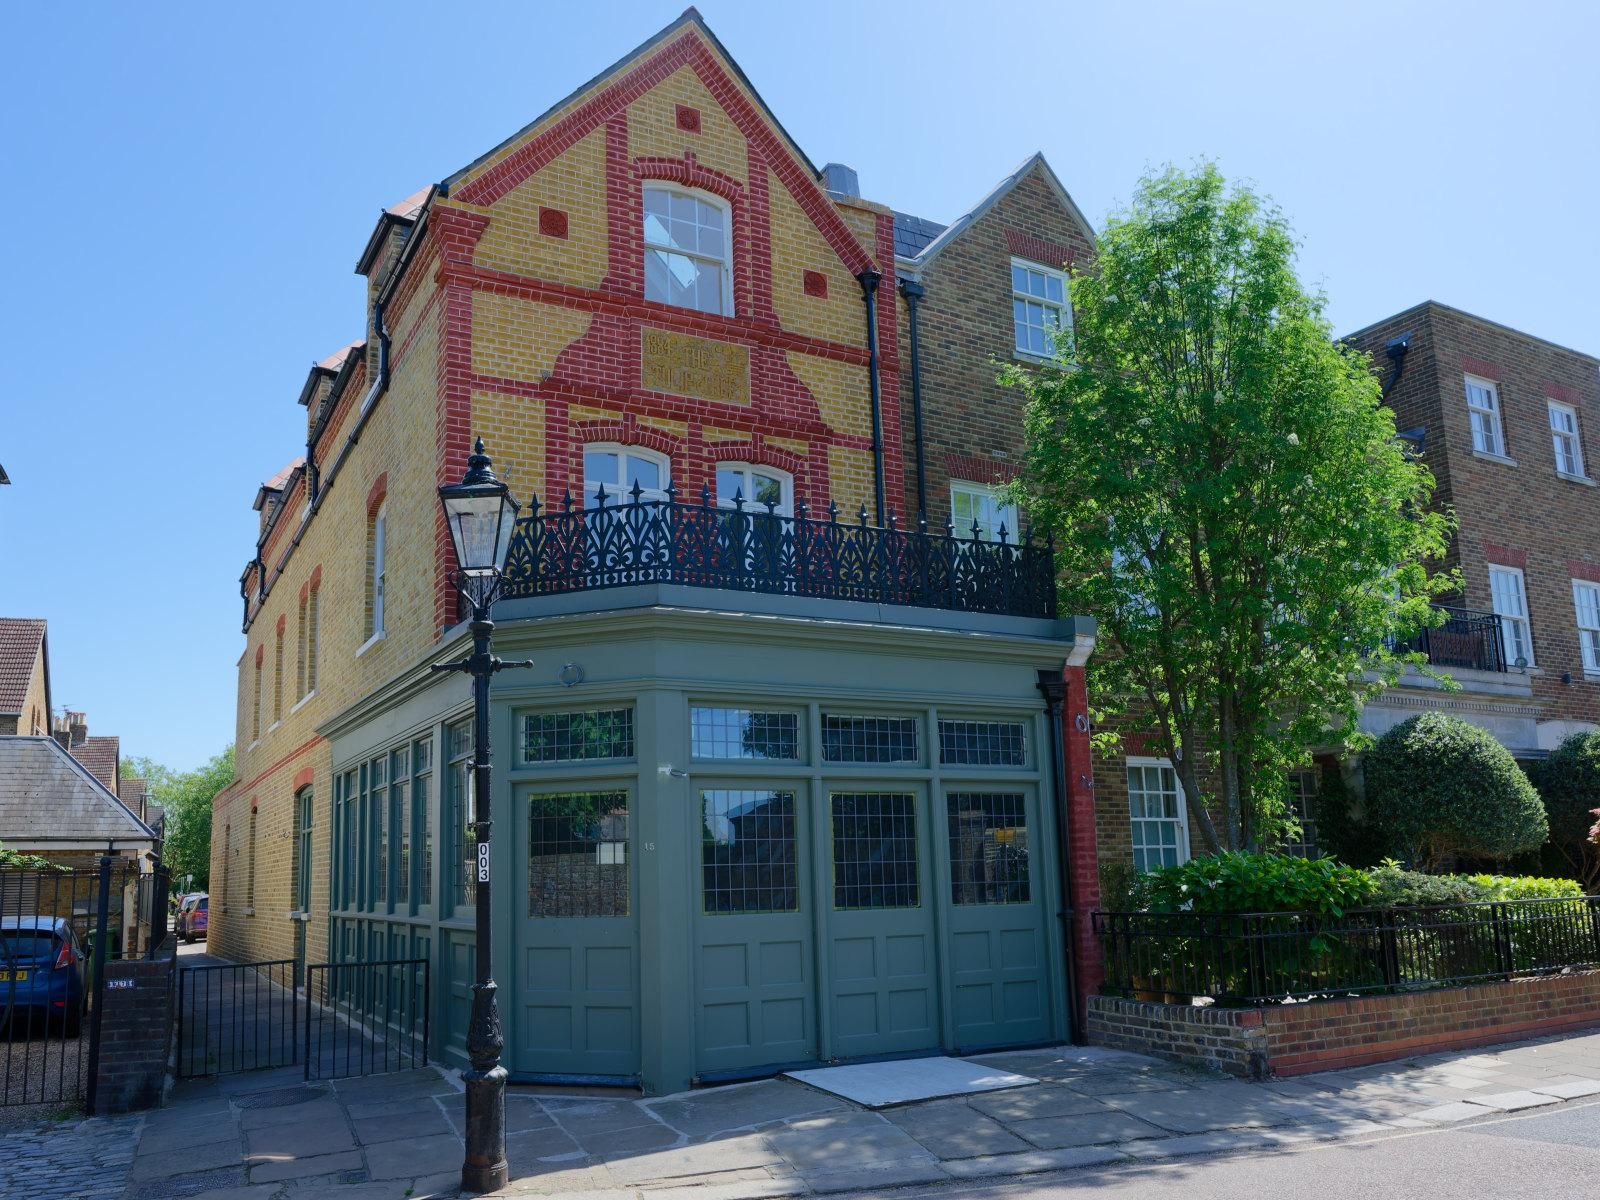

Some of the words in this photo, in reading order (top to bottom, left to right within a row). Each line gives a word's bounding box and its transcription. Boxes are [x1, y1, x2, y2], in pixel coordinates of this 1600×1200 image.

[682, 347, 709, 371] THE
[644, 842, 655, 851] 15
[479, 844, 488, 881] 003
